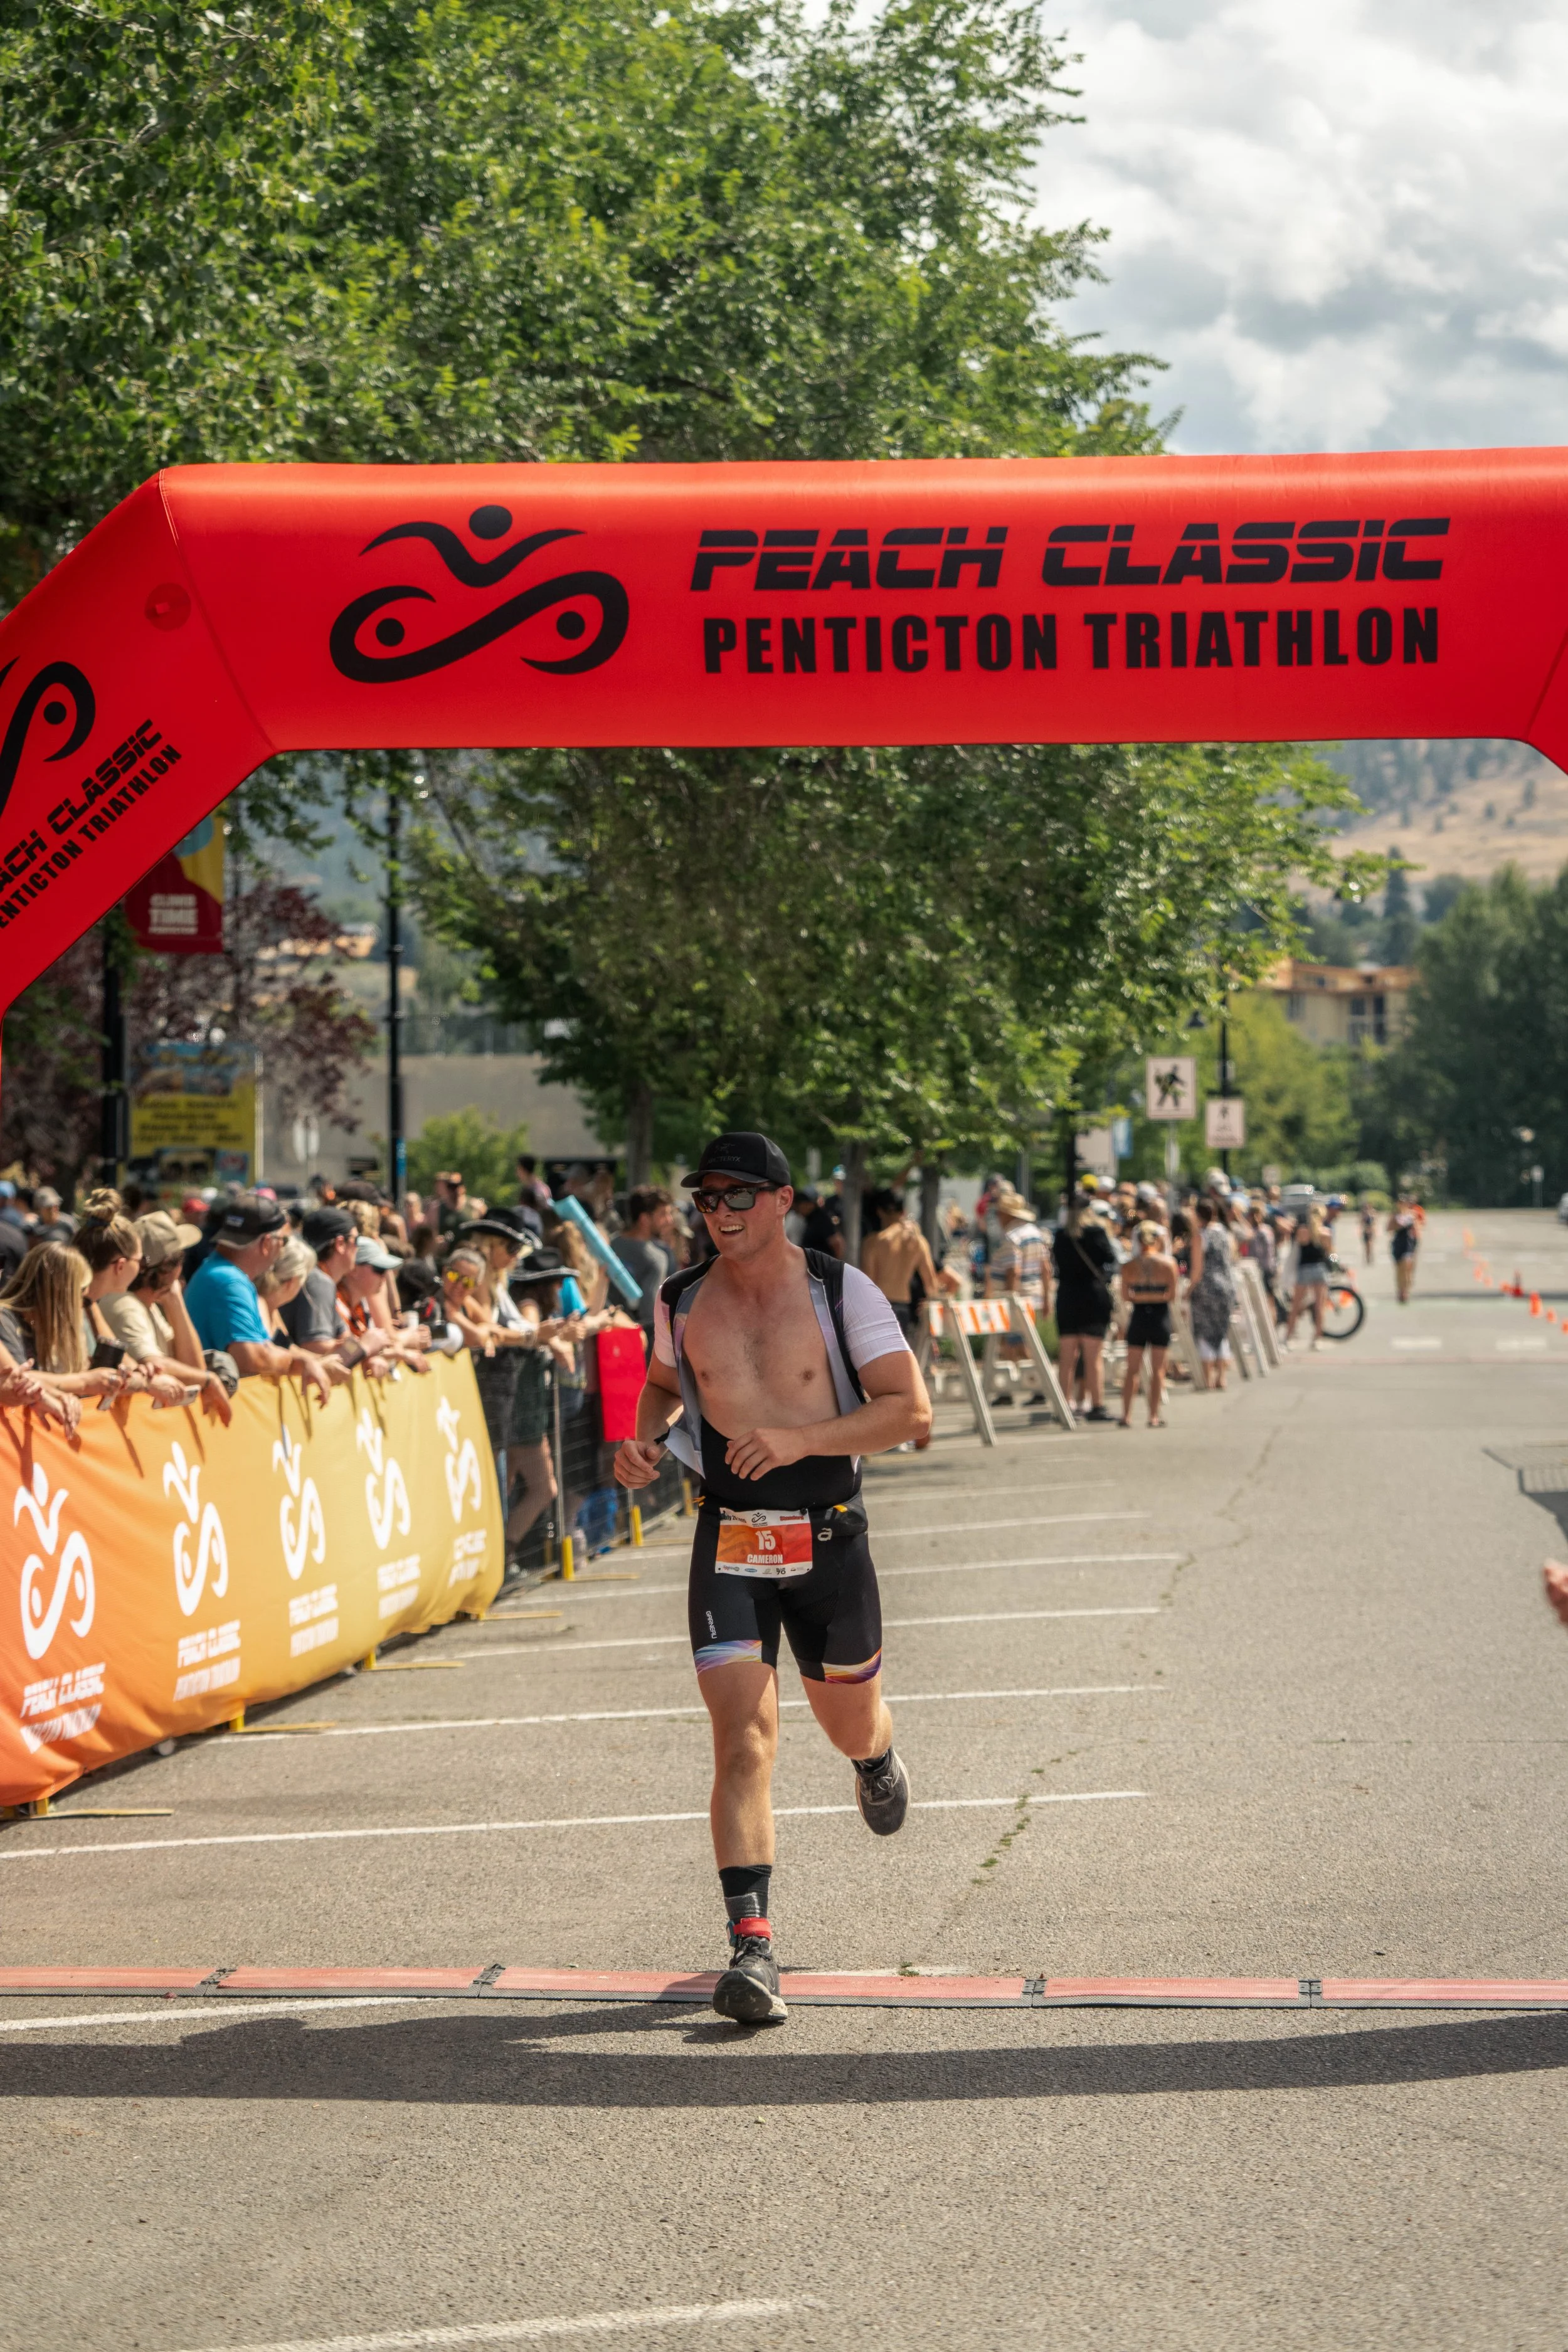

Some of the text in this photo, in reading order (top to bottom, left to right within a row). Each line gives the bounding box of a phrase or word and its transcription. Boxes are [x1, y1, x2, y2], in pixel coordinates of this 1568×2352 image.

[690, 517, 1451, 591] PEACH CLASSIC
[703, 607, 1438, 674] PENTICTON TRIATHLON
[47, 719, 162, 835] CLASSIC
[78, 744, 181, 842] TRIATHLON
[747, 1554, 783, 1564] CAMERON
[755, 1530, 776, 1550] 15
[706, 1610, 718, 1640] GARNEAU
